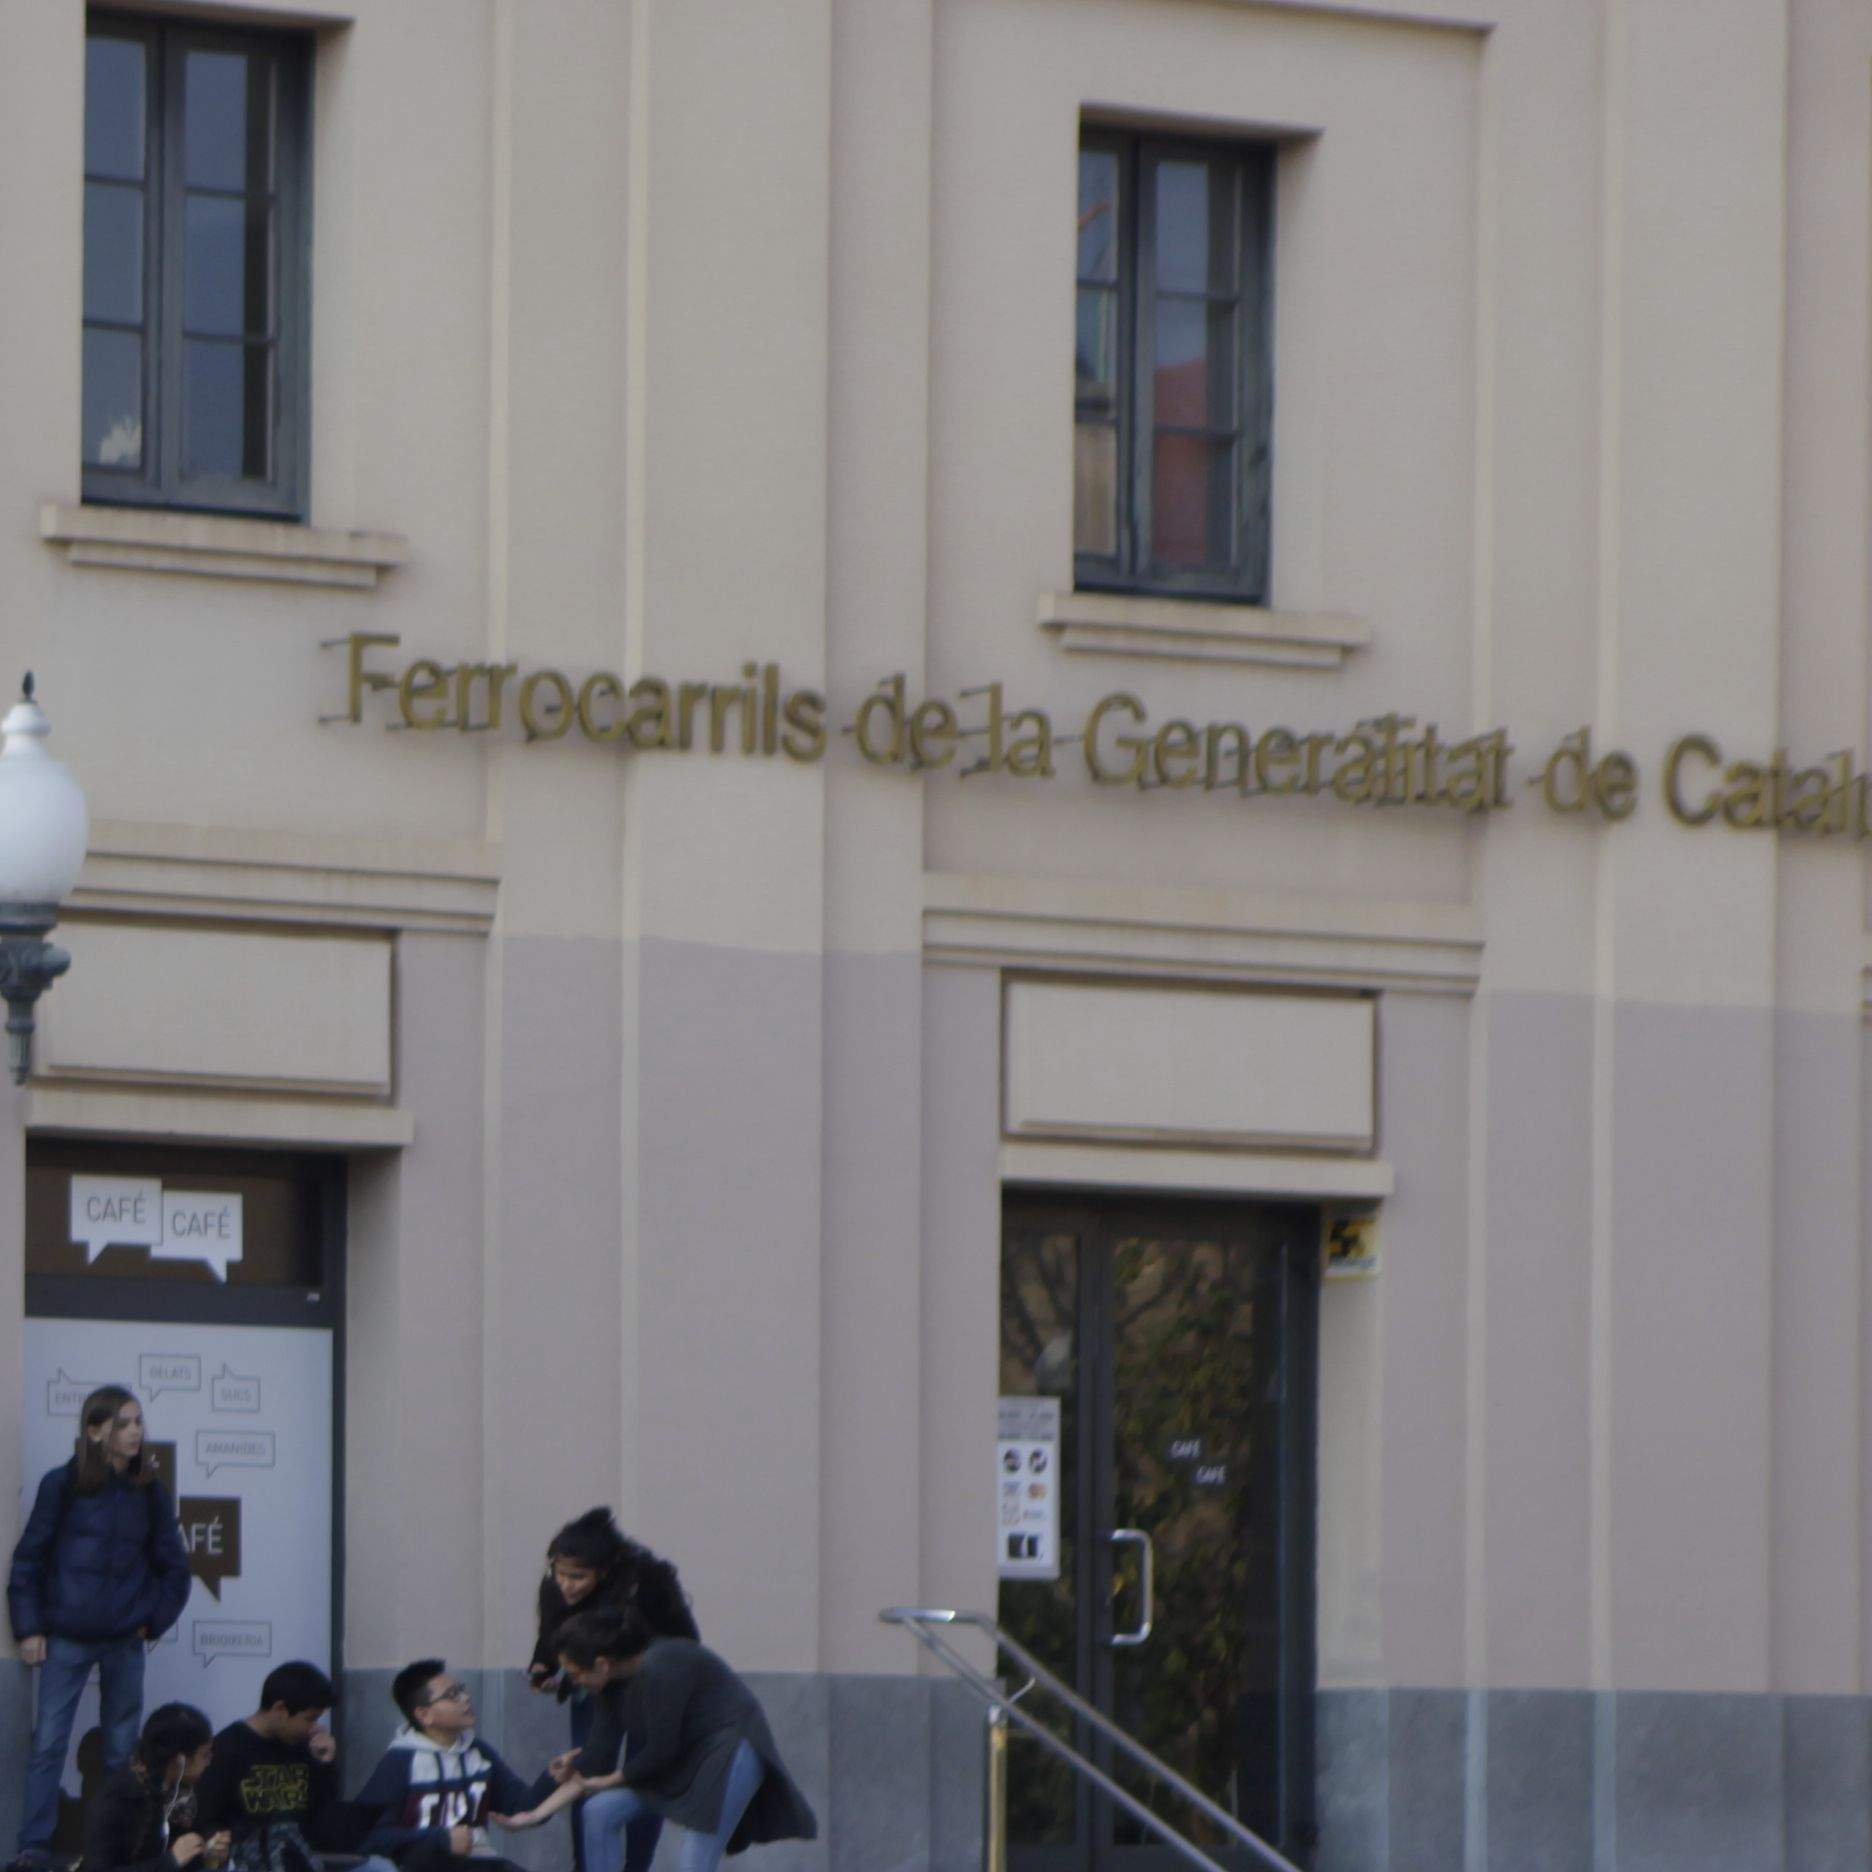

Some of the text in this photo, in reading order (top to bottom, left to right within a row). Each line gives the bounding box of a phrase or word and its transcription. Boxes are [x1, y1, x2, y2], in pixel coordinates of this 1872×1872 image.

[347, 631, 828, 763] Ferrocarrils
[854, 673, 958, 773] de
[987, 681, 1057, 779] la
[1082, 691, 1516, 813] Generalitat
[1542, 725, 1641, 822] de
[86, 1190, 148, 1225] CAFÉ
[172, 1204, 233, 1240] CAFÉ
